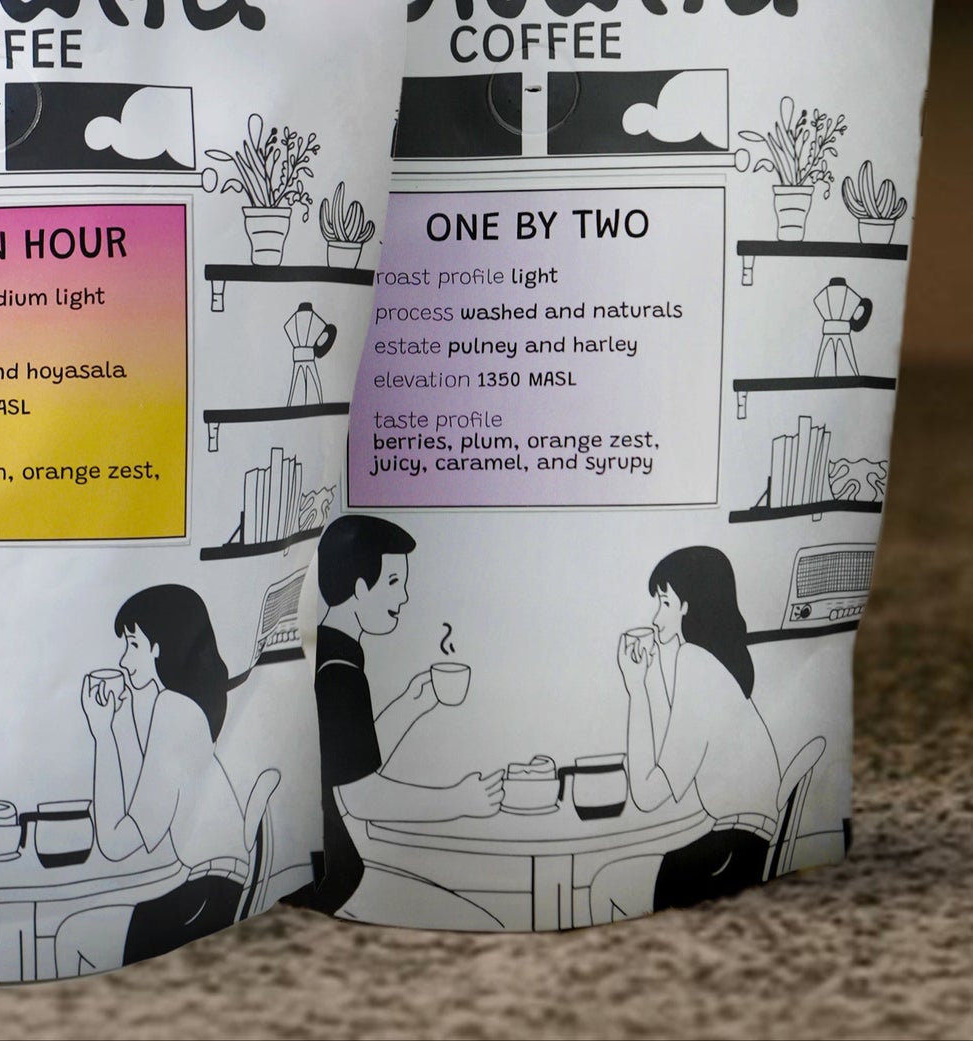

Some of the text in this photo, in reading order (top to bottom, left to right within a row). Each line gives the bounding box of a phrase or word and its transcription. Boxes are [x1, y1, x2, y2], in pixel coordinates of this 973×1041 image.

[450, 21, 622, 63] COFFEE
[426, 209, 649, 242] ONE BY TWO
[25, 227, 127, 259] HOUR
[376, 267, 558, 288] roast profile light
[56, 288, 105, 309] light
[376, 301, 683, 324] process washed and naturals
[375, 336, 637, 358] estate pulney and harley
[27, 361, 127, 383] hoyasala
[374, 372, 576, 388] elevation 1350 MASL
[374, 411, 502, 432] taste profile
[373, 432, 659, 452] berries, plum, orange zest,
[23, 464, 100, 484] orange
[108, 462, 160, 481] zest,
[369, 453, 652, 475] juicy, caramel, and syrupy
